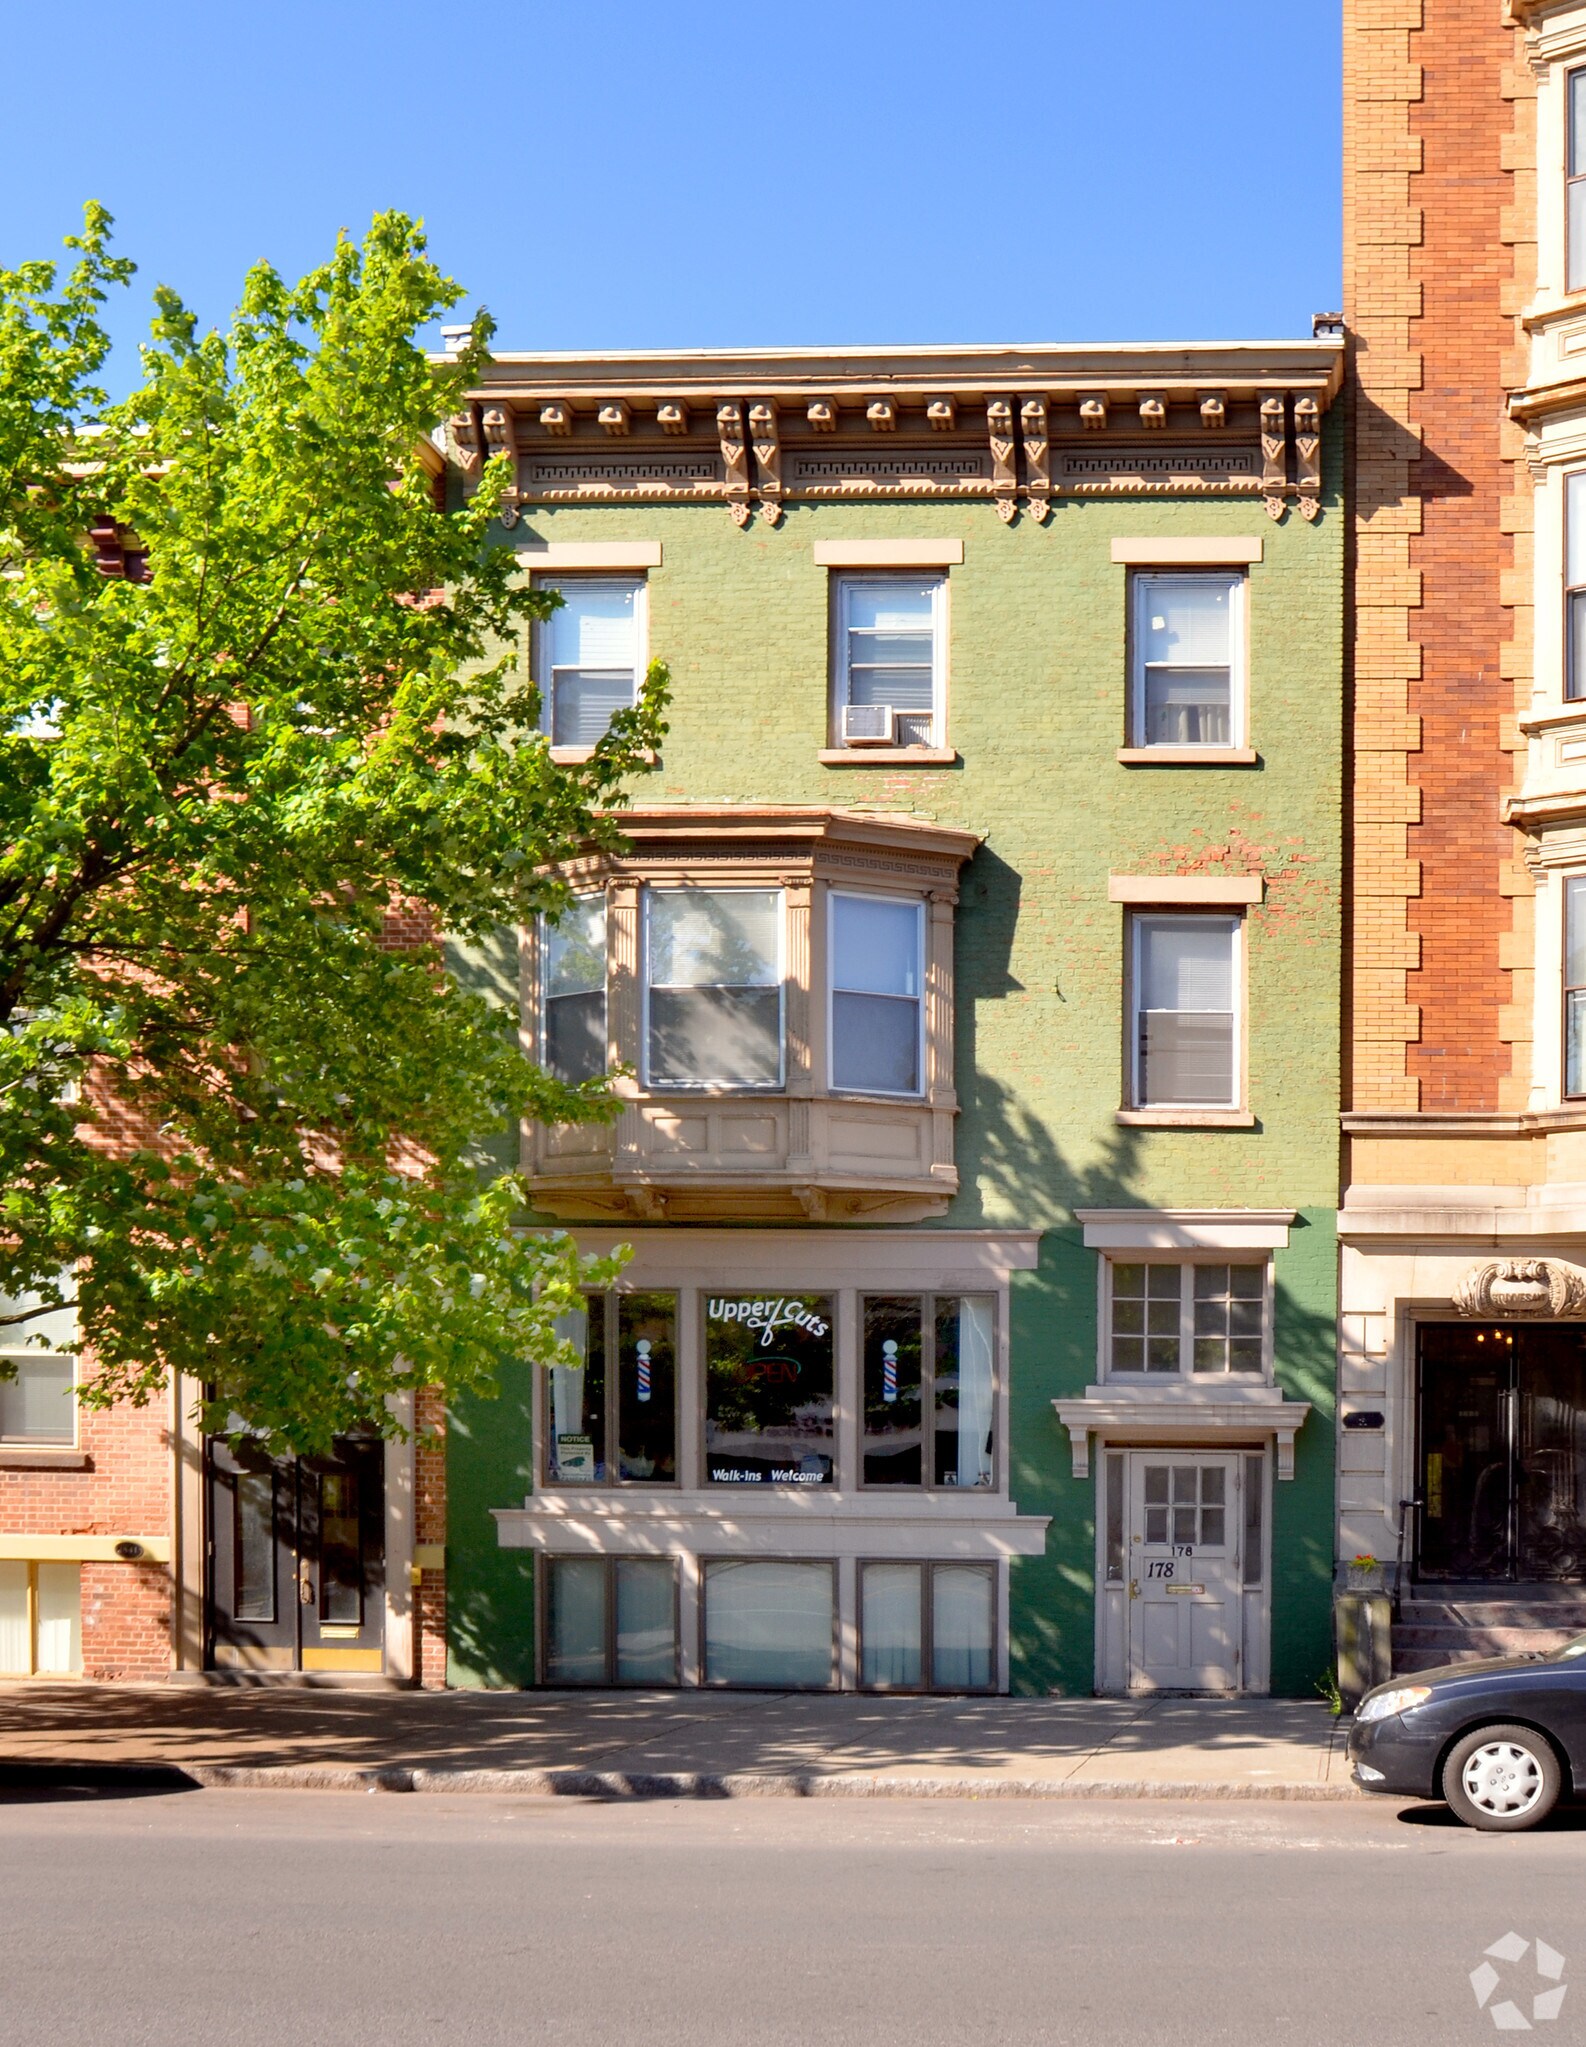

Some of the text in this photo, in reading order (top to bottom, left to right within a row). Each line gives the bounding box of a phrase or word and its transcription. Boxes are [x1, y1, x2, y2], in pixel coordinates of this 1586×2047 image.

[709, 1299, 829, 1336] Upper Cuts
[560, 1435, 591, 1443] NOTICE
[712, 1469, 824, 1482] Walk-ins Welcome
[1171, 1546, 1193, 1557] 178
[1147, 1562, 1175, 1578] 178
